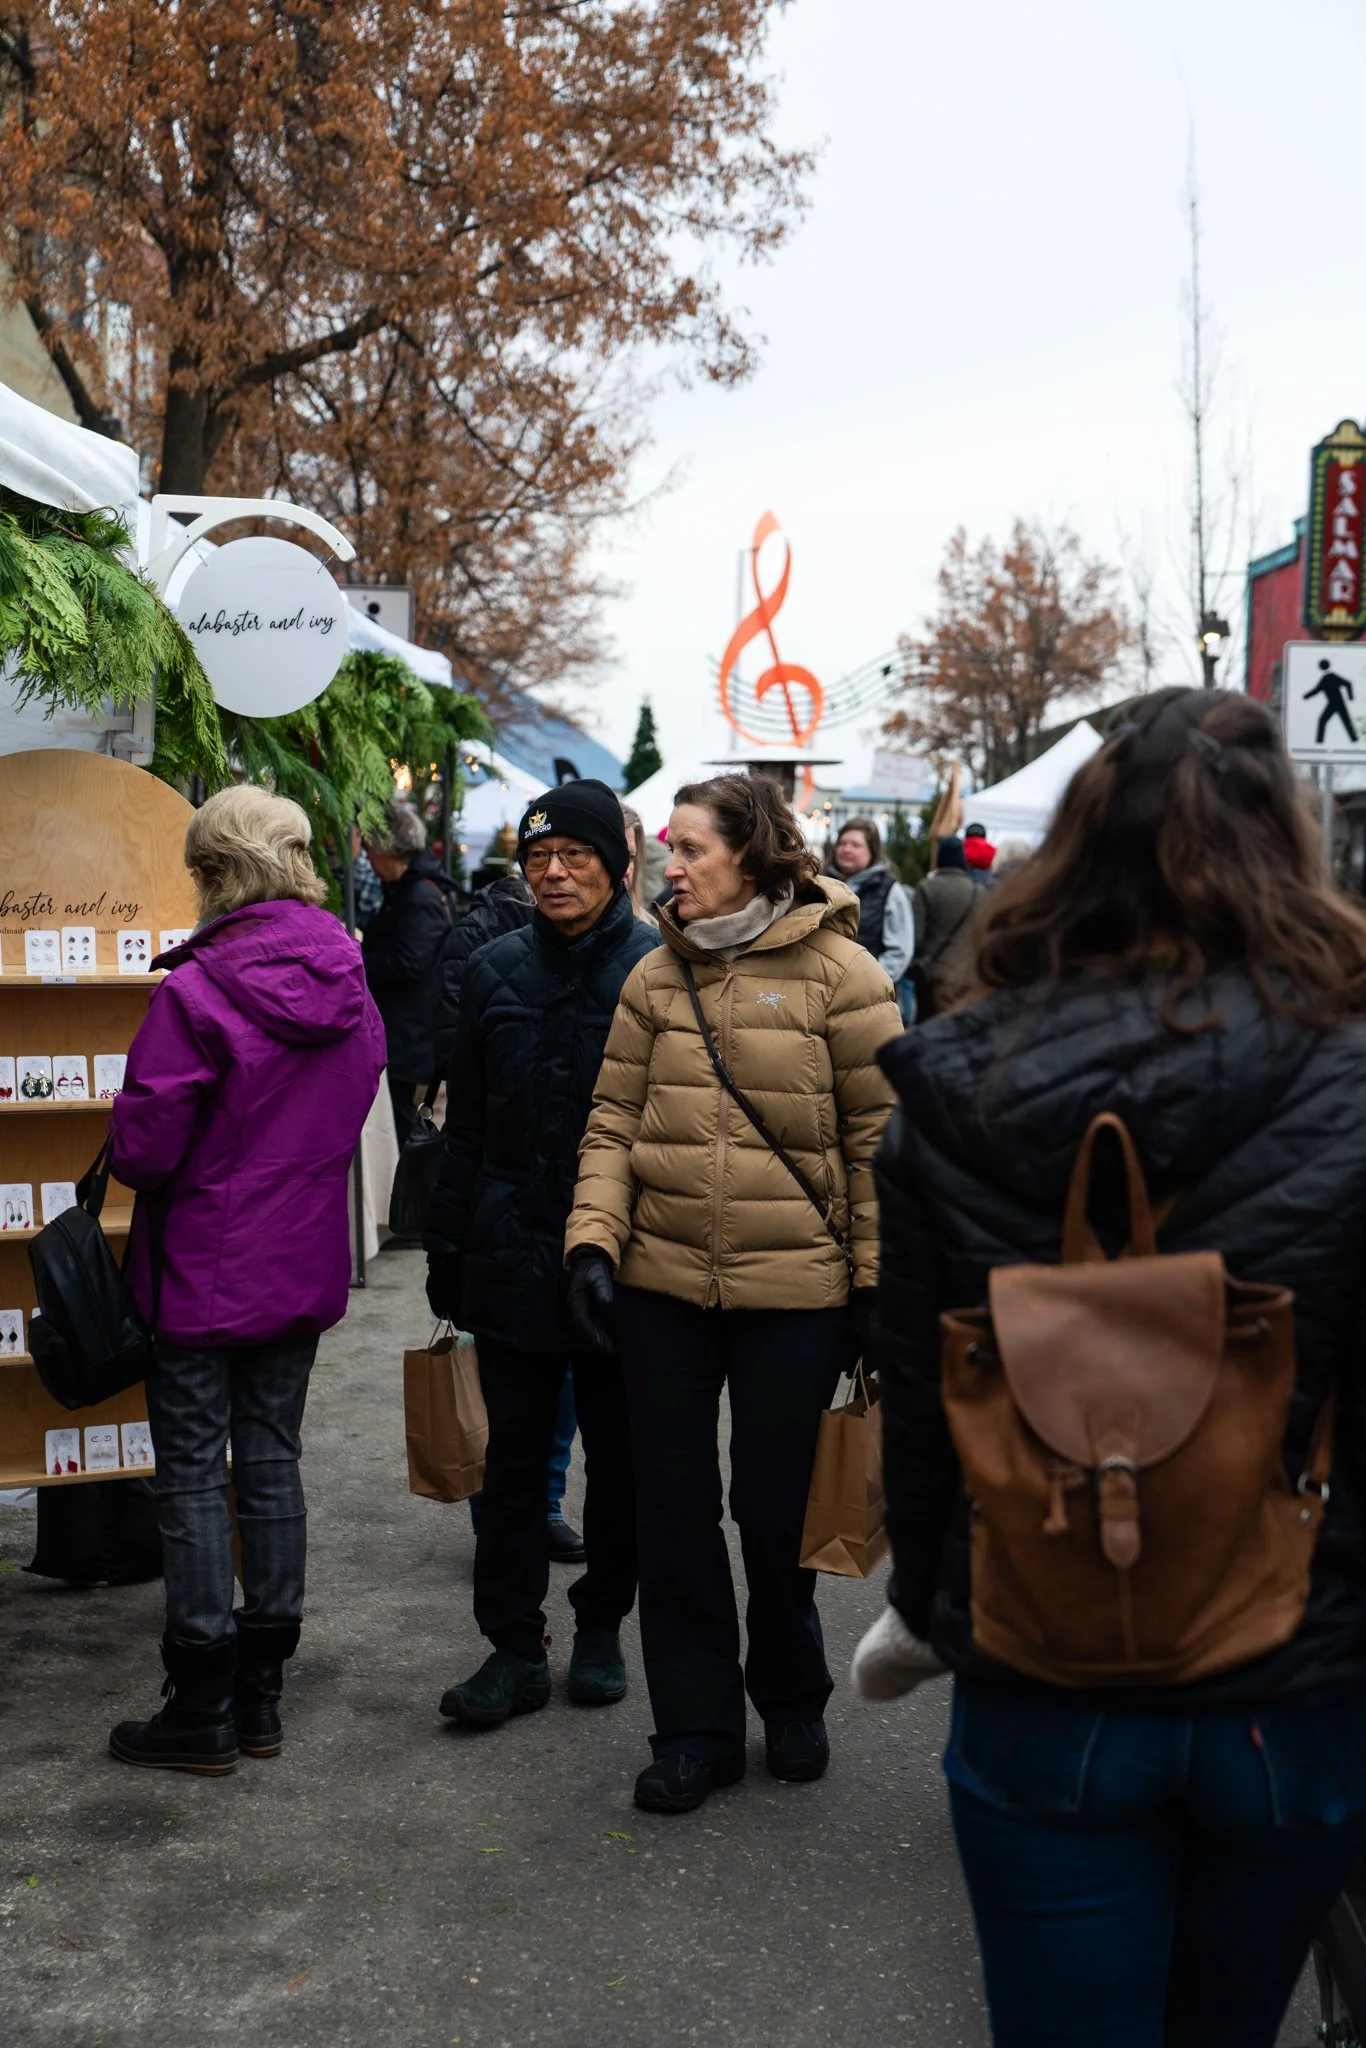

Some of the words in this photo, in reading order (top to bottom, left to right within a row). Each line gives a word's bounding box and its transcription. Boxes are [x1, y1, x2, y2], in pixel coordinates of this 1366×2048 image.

[1328, 469, 1359, 602] SALMAR
[189, 609, 263, 636] alabaster
[269, 607, 304, 631] and
[309, 615, 337, 635] ivy
[524, 823, 552, 839] SAPPORO
[64, 891, 107, 916] and
[111, 900, 142, 922] ivy
